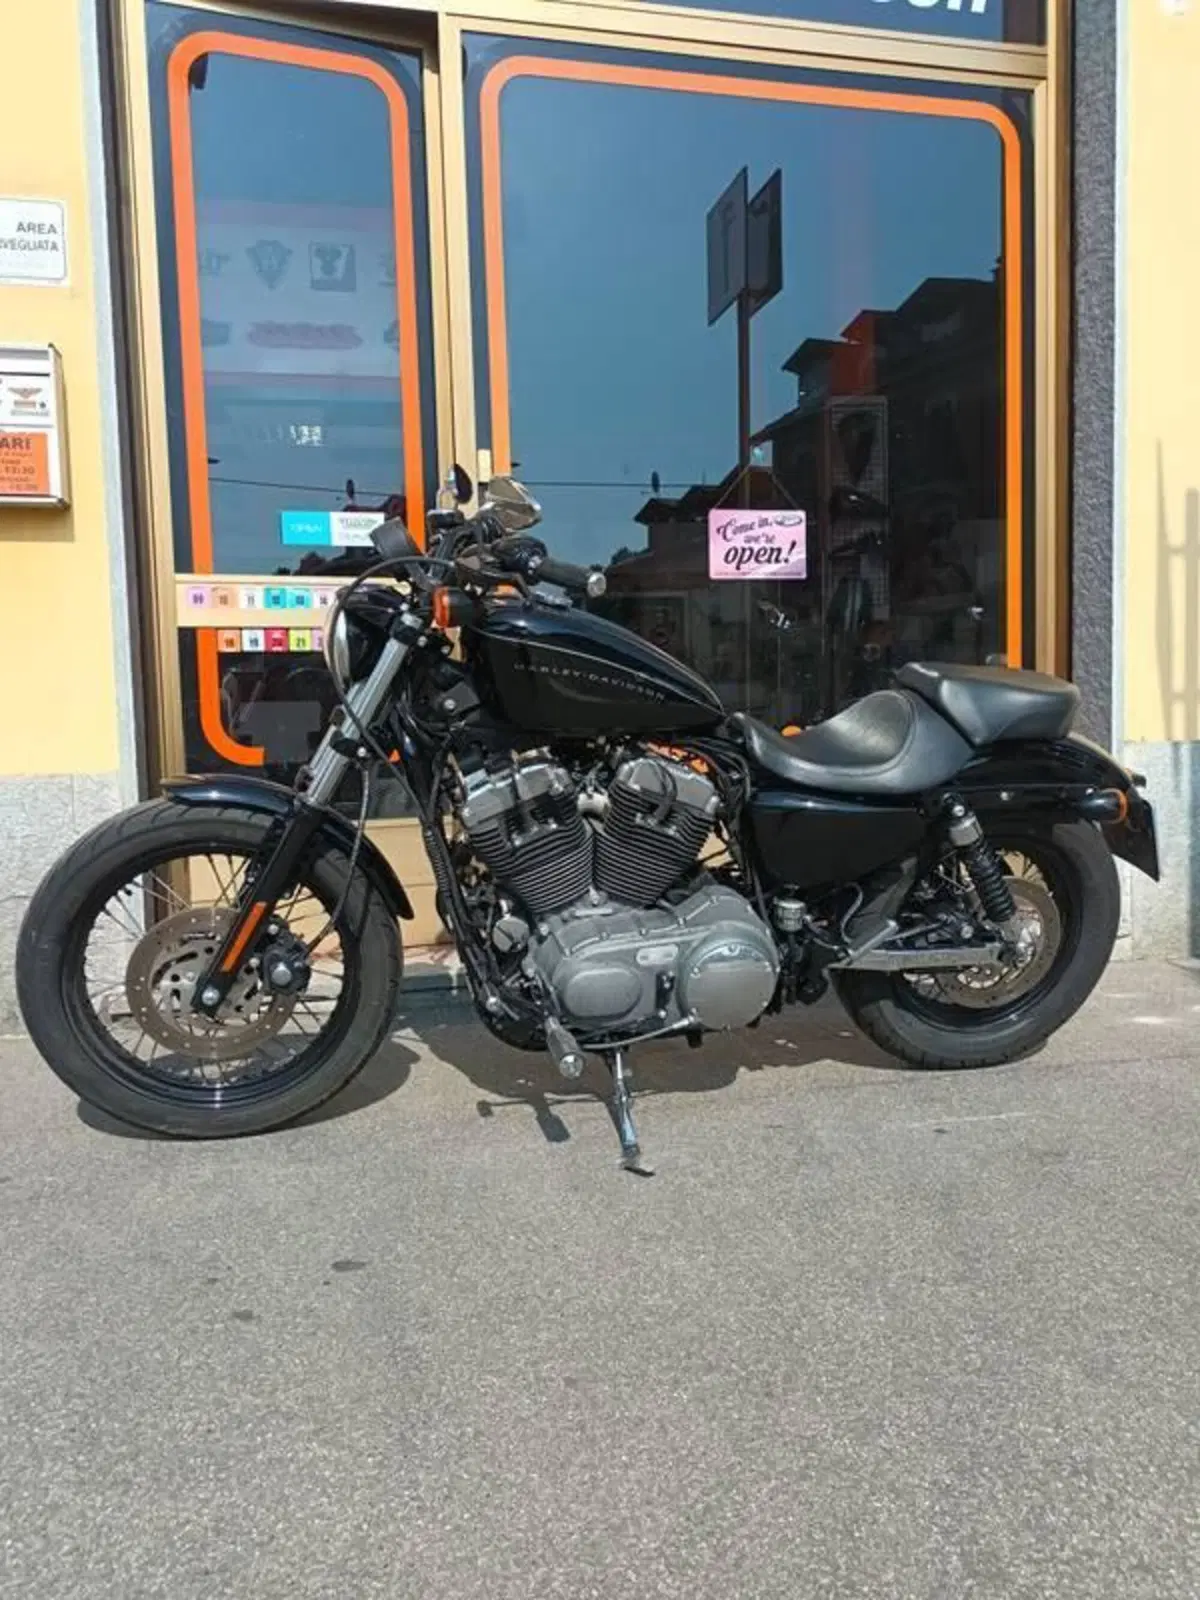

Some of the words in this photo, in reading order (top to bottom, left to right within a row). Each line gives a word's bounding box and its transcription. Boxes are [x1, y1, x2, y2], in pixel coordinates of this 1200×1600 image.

[16, 222, 57, 234] AREA
[717, 518, 755, 542] Come
[724, 540, 796, 570] open!
